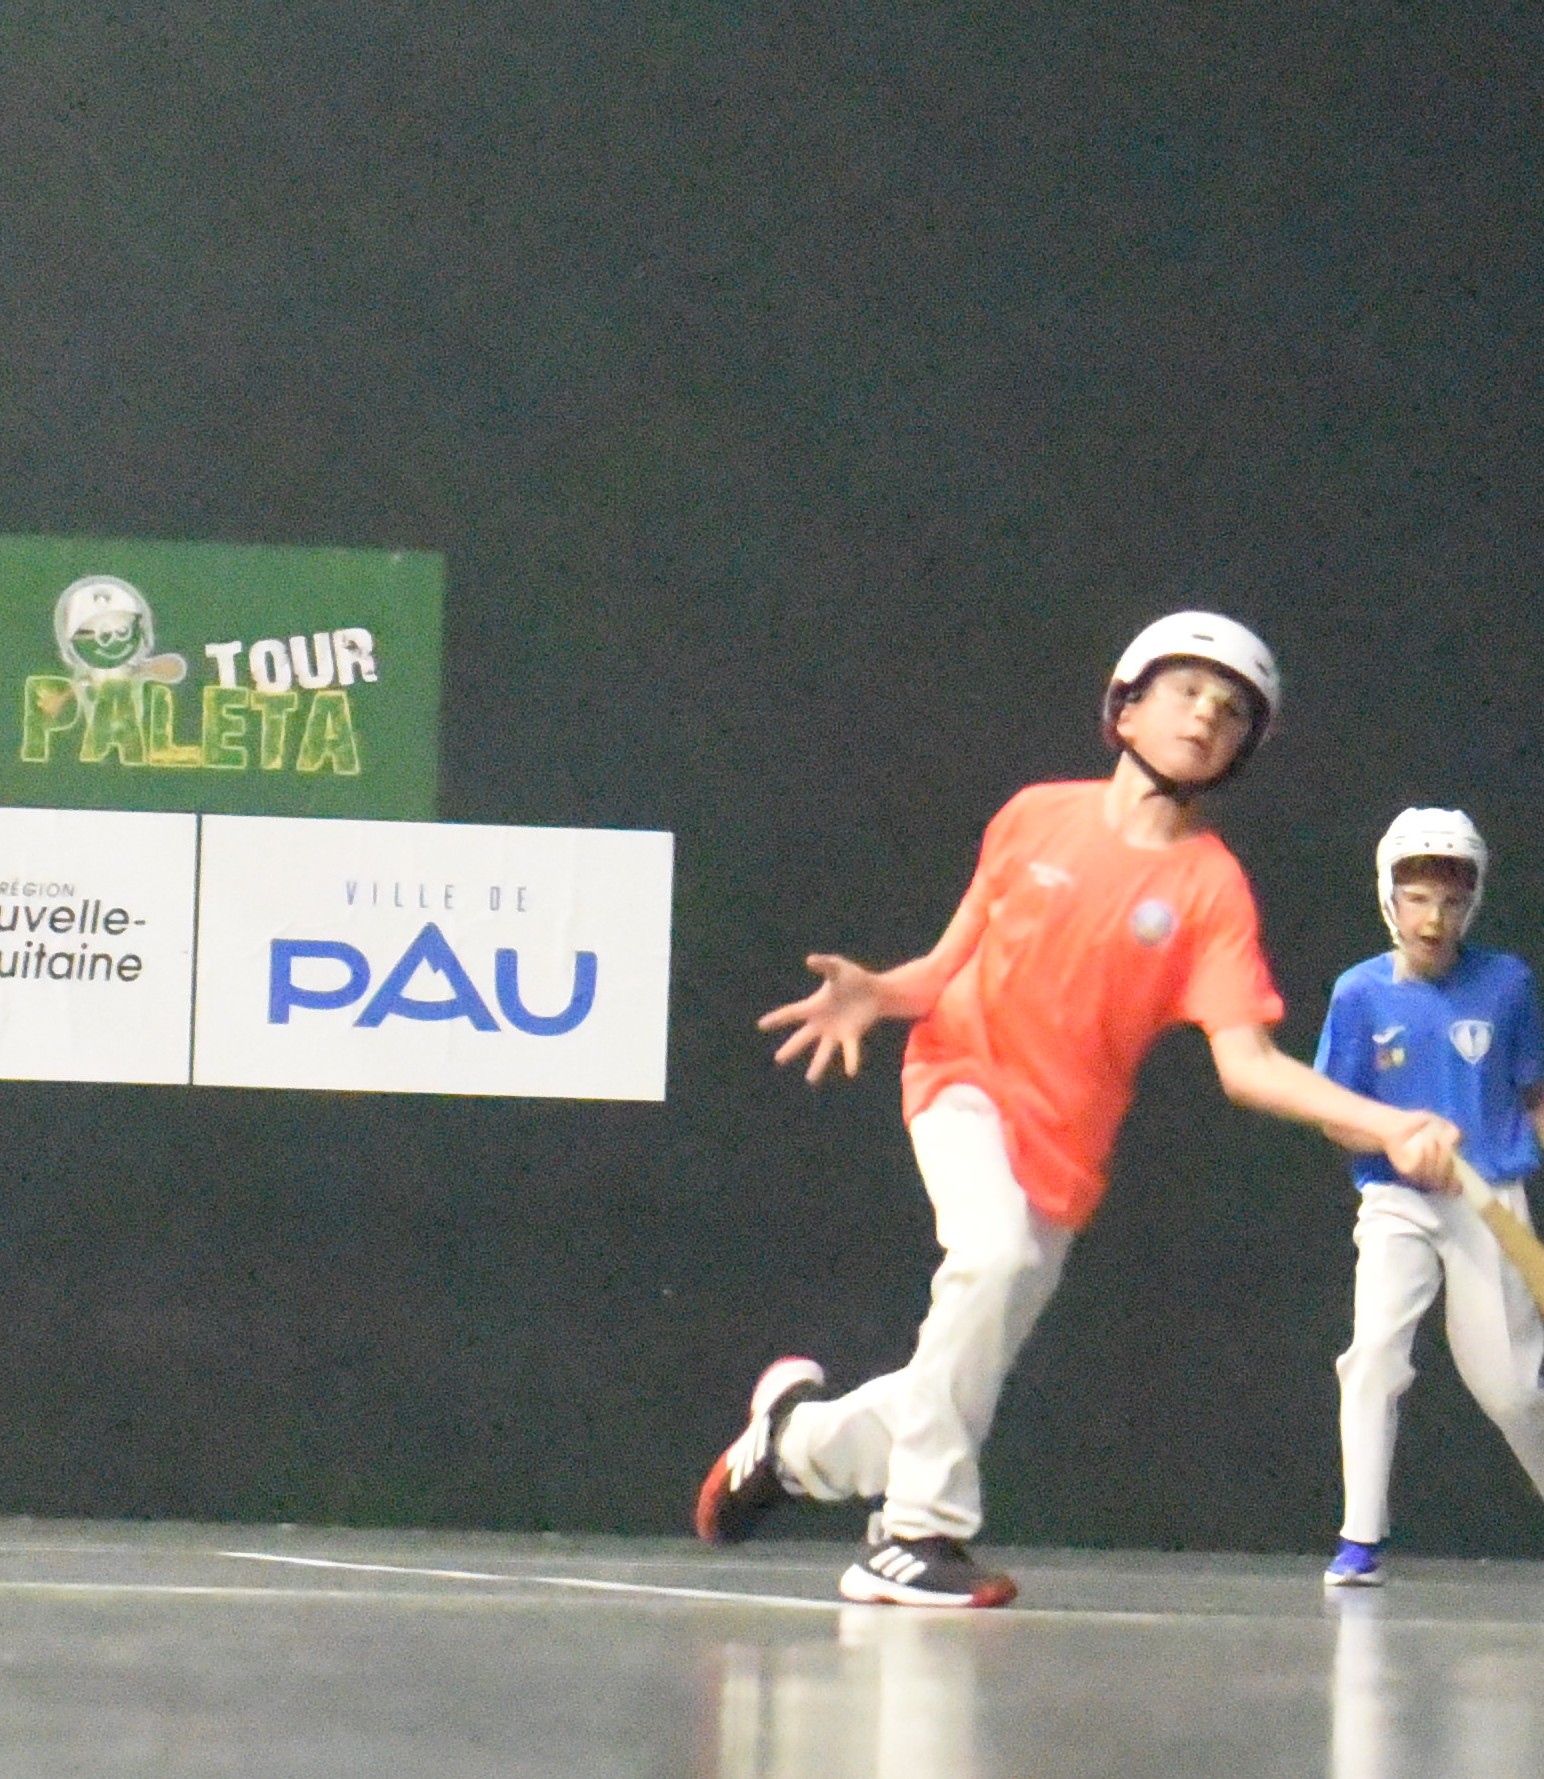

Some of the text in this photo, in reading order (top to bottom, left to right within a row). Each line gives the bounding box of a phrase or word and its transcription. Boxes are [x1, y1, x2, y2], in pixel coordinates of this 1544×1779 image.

[205, 627, 378, 691] TOUR
[20, 675, 362, 776] PALETA
[346, 881, 527, 913] VILLE DE
[268, 921, 598, 1037] PAU
